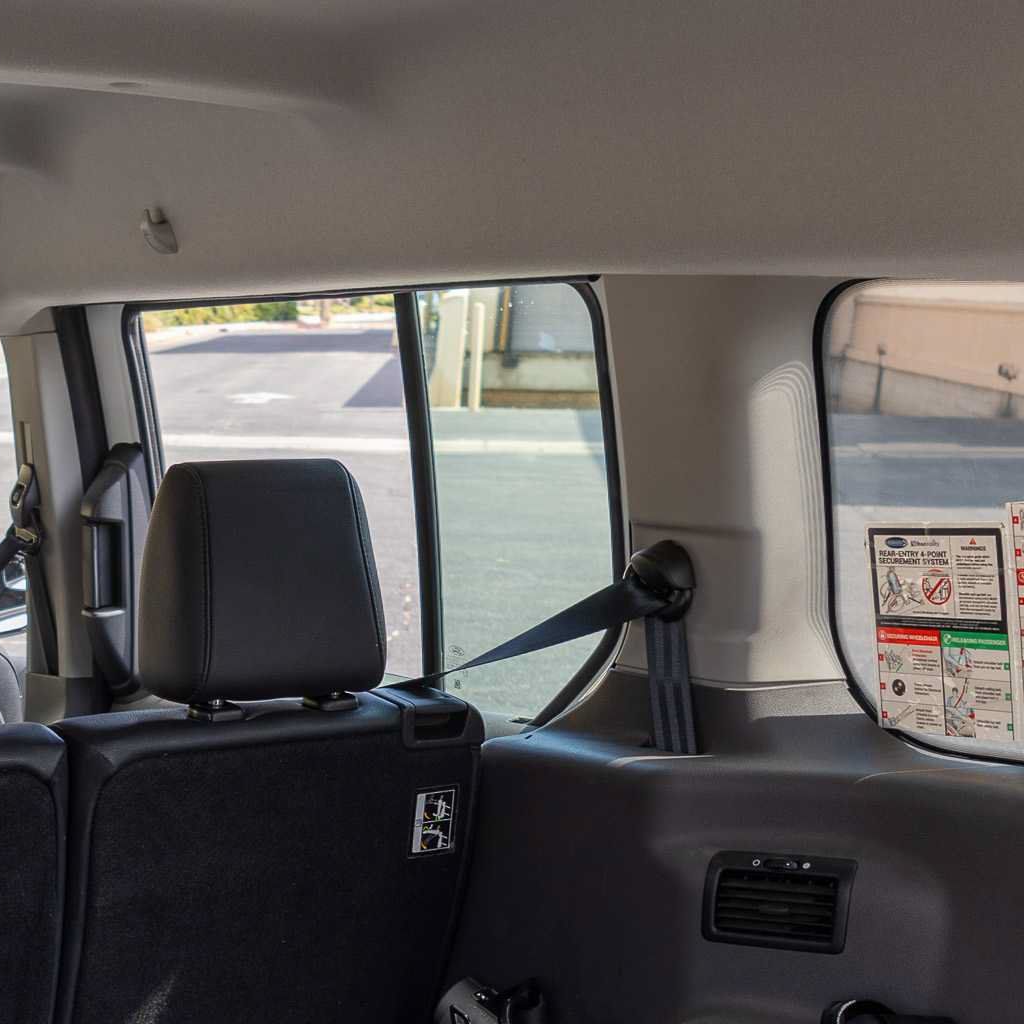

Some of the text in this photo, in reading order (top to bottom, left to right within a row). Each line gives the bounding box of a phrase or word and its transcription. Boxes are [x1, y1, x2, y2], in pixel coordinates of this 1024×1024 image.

[879, 550, 947, 558] REAR-ENTRY 4-POINT
[878, 557, 921, 565] SECUREMENT
[923, 558, 949, 566] SYSTEM
